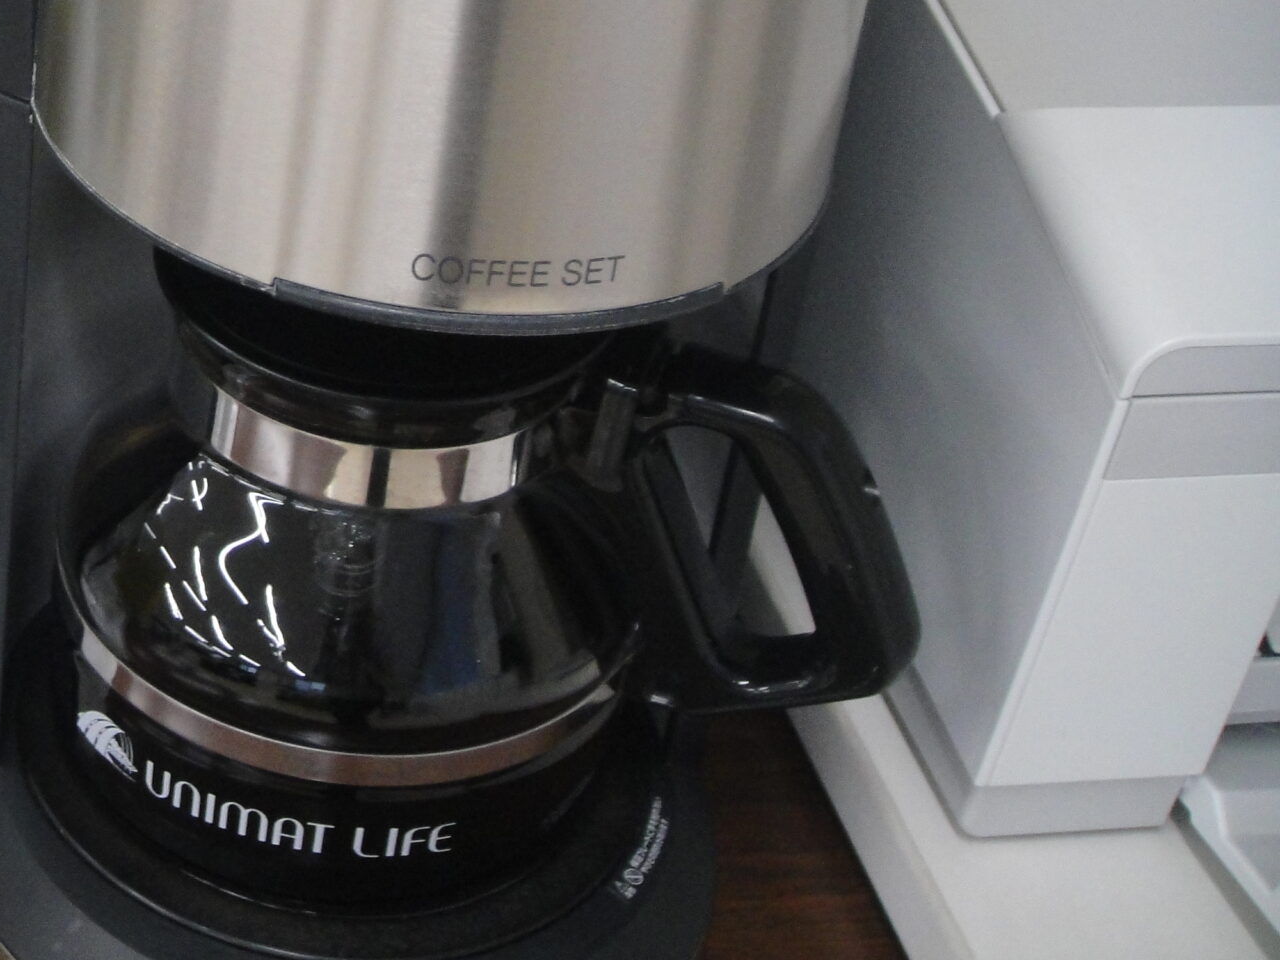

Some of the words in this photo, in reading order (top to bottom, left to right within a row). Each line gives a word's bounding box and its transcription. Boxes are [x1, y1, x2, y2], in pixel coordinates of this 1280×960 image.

[411, 253, 552, 288] COFFEE
[561, 254, 626, 287] SET
[144, 759, 335, 855] UNIMAT
[351, 822, 457, 859] LIFE
